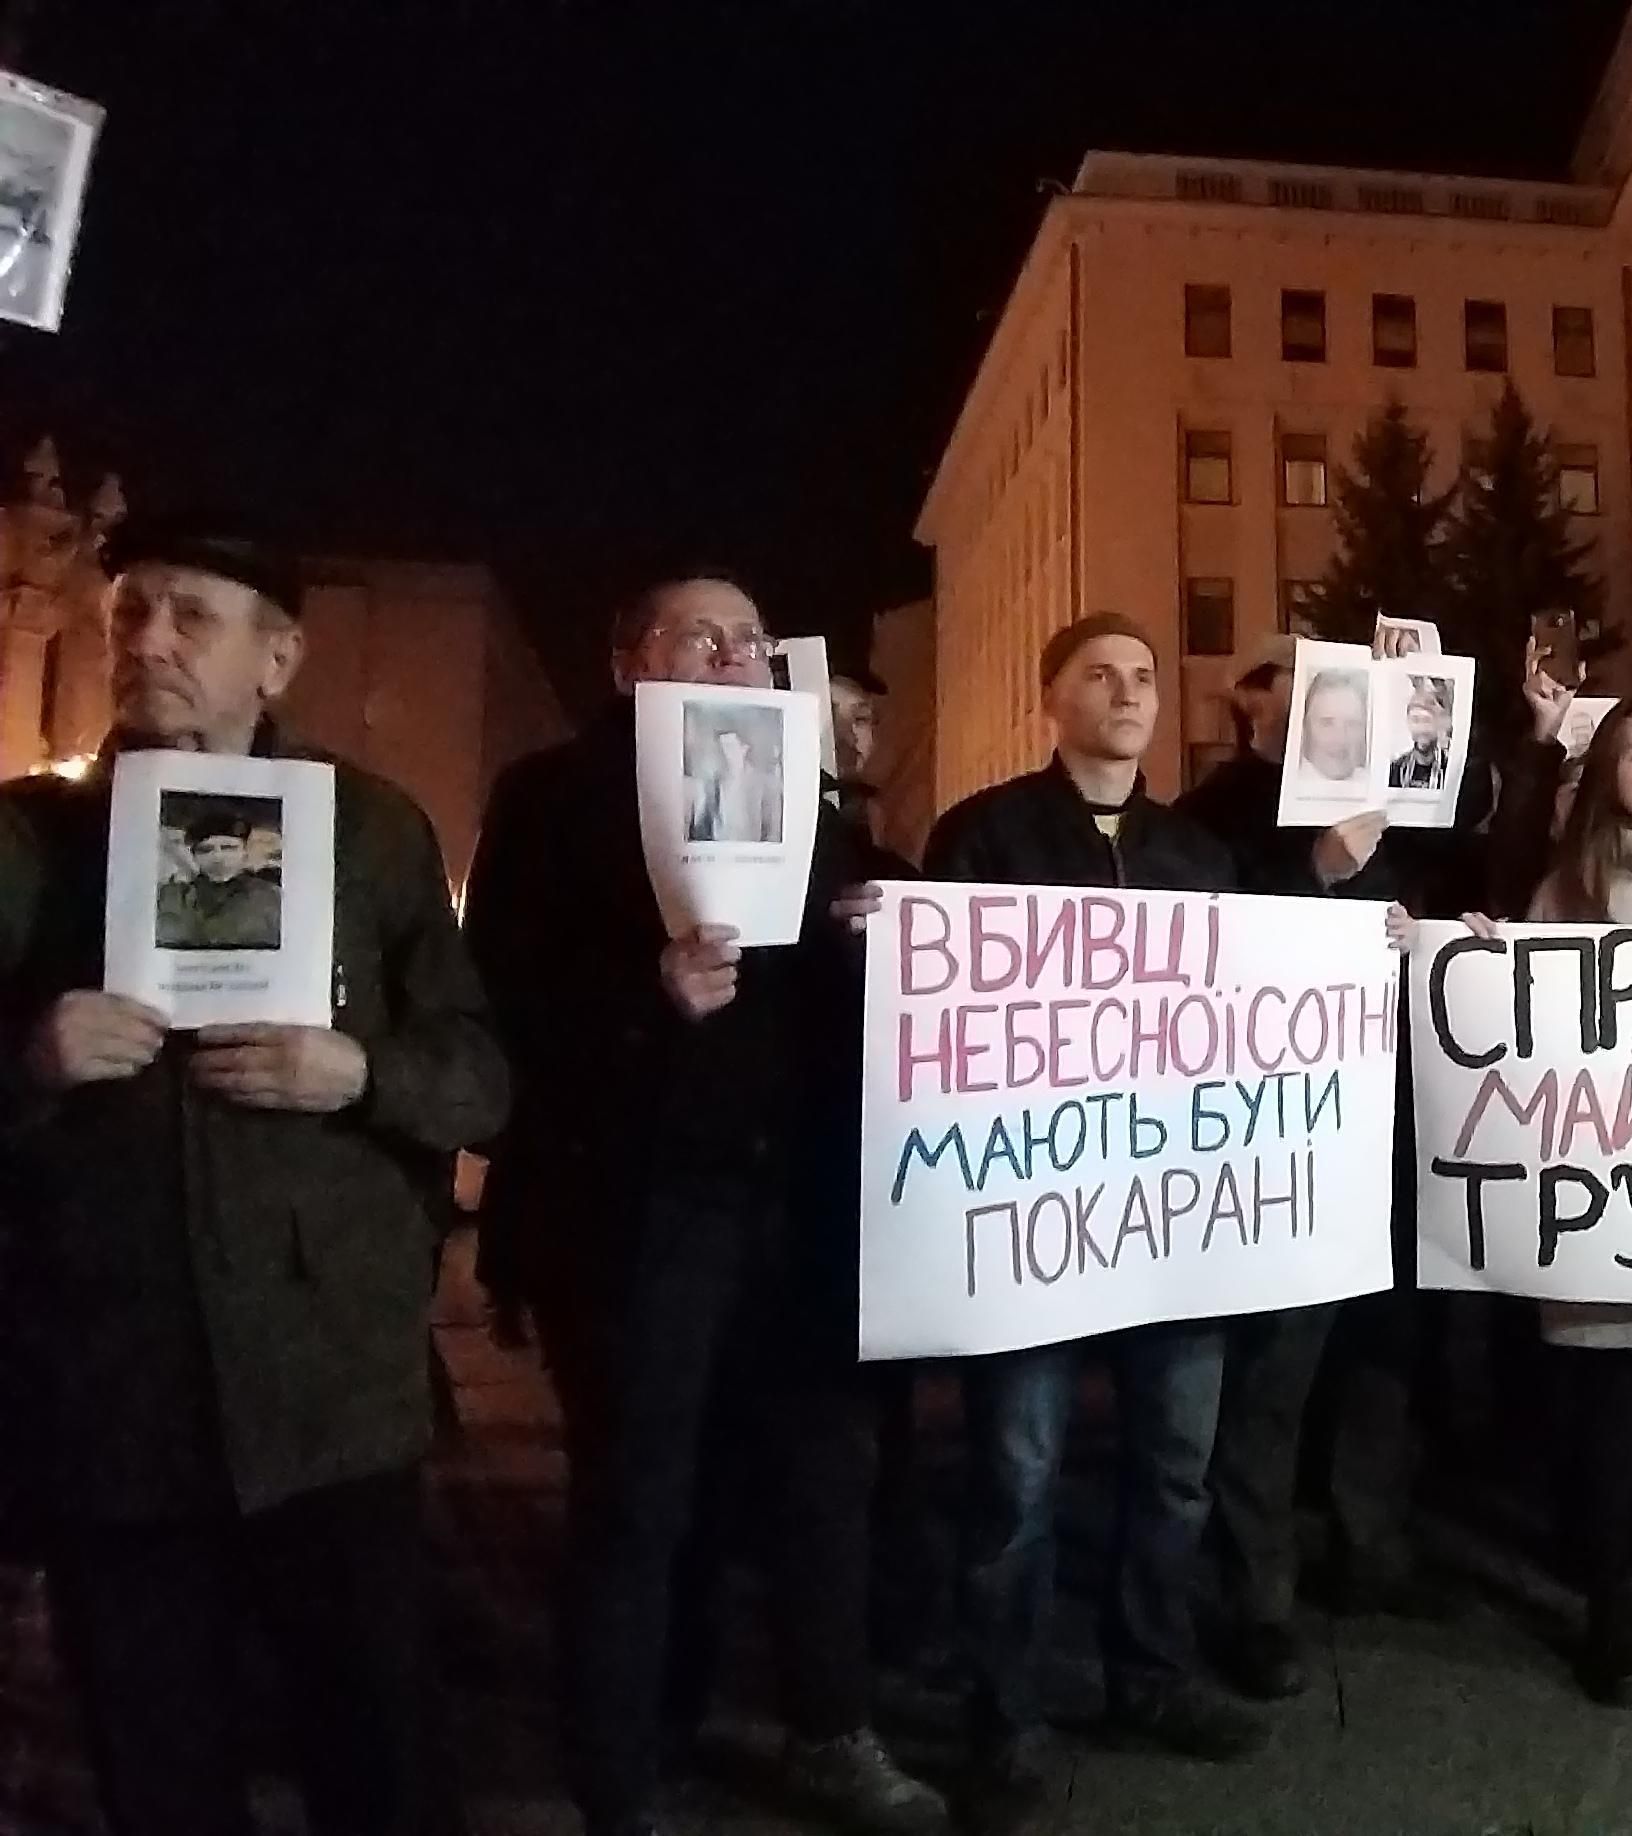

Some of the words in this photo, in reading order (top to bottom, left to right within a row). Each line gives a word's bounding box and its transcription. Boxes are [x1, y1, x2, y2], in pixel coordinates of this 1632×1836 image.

[900, 893, 1219, 996] ВБИВЦІ
[900, 986, 1242, 1102] НЕБЕСНОЇ
[1247, 970, 1396, 1072] СОТНІ
[891, 1093, 1167, 1206] МАЮТЬ
[1191, 1070, 1342, 1152] БУТИ
[965, 1140, 1315, 1297] ПОКАРАНІ
